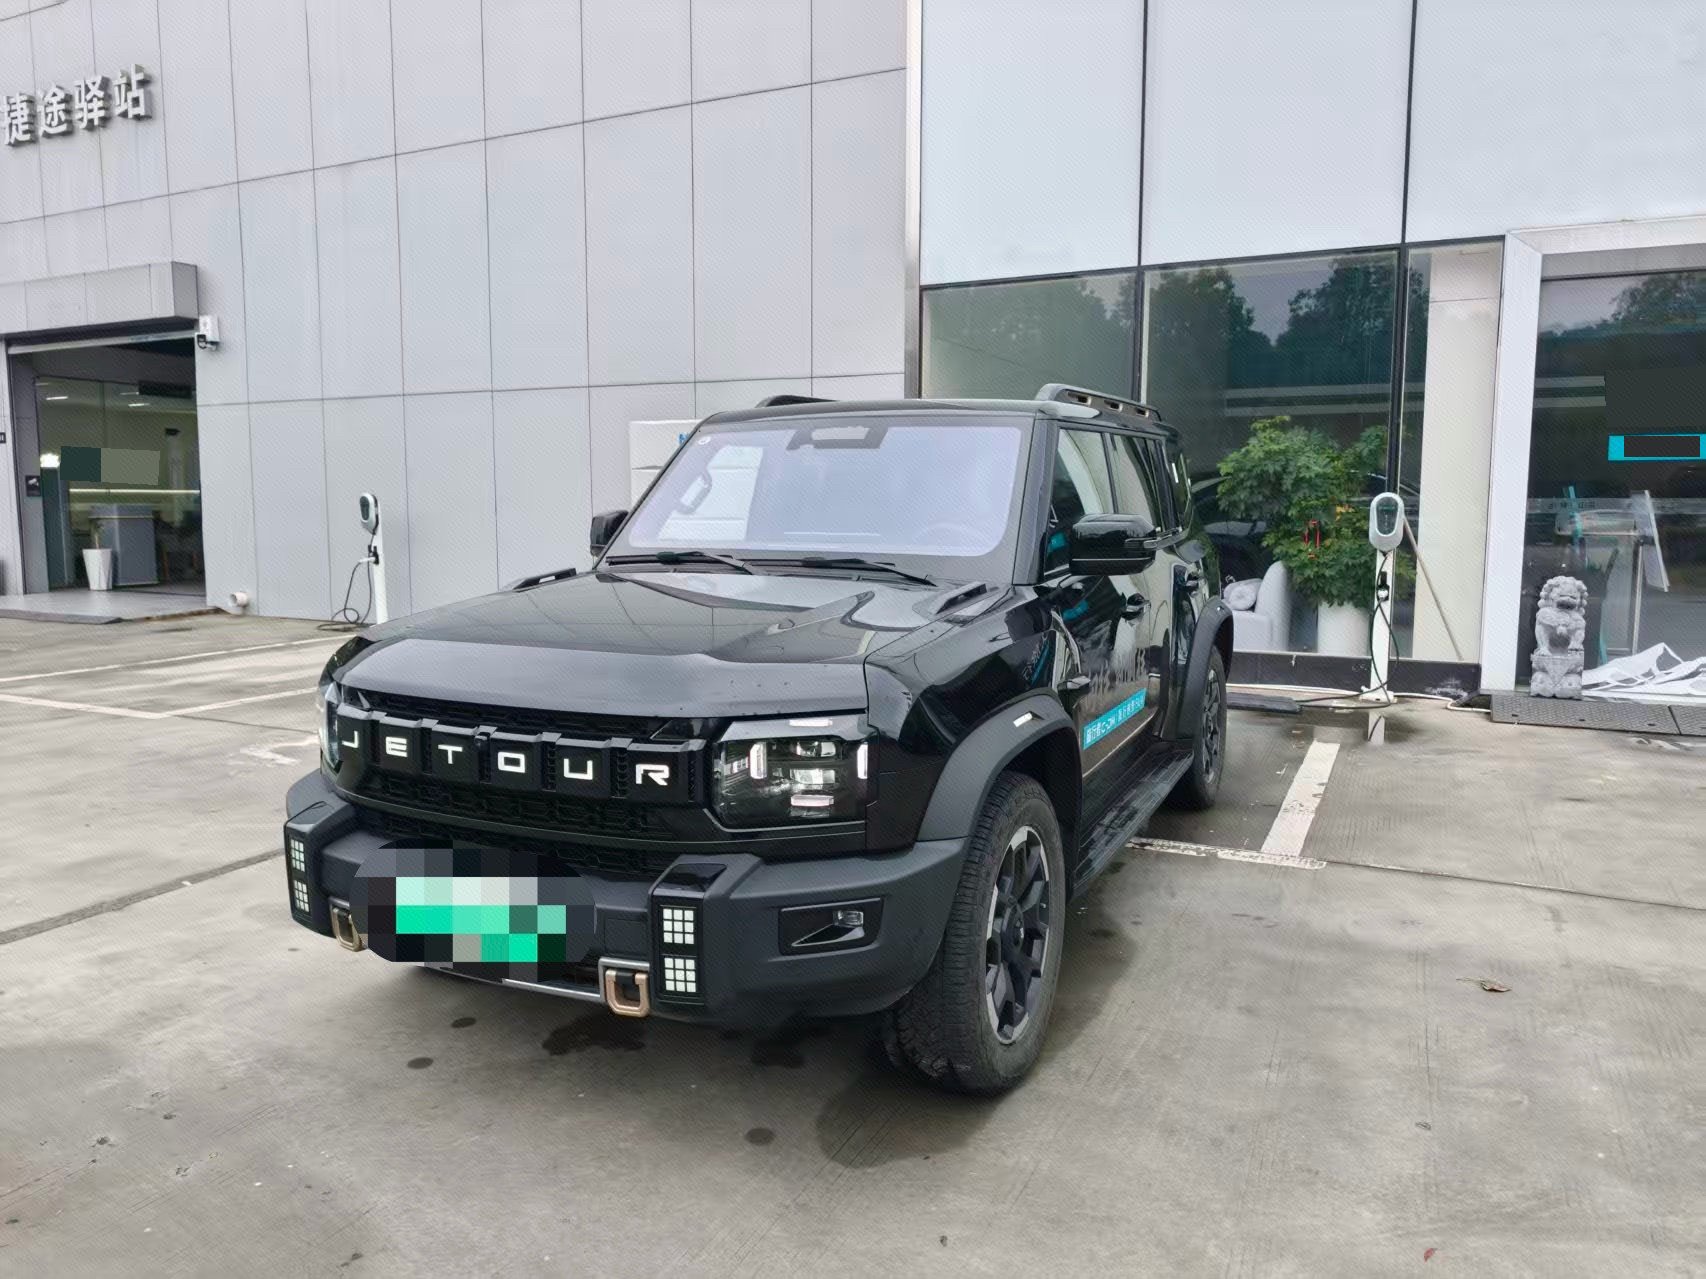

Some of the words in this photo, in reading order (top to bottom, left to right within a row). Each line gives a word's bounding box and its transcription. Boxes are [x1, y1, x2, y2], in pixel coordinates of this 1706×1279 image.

[0, 64, 147, 145] 捷途驿站
[342, 730, 670, 786] JETOUR
